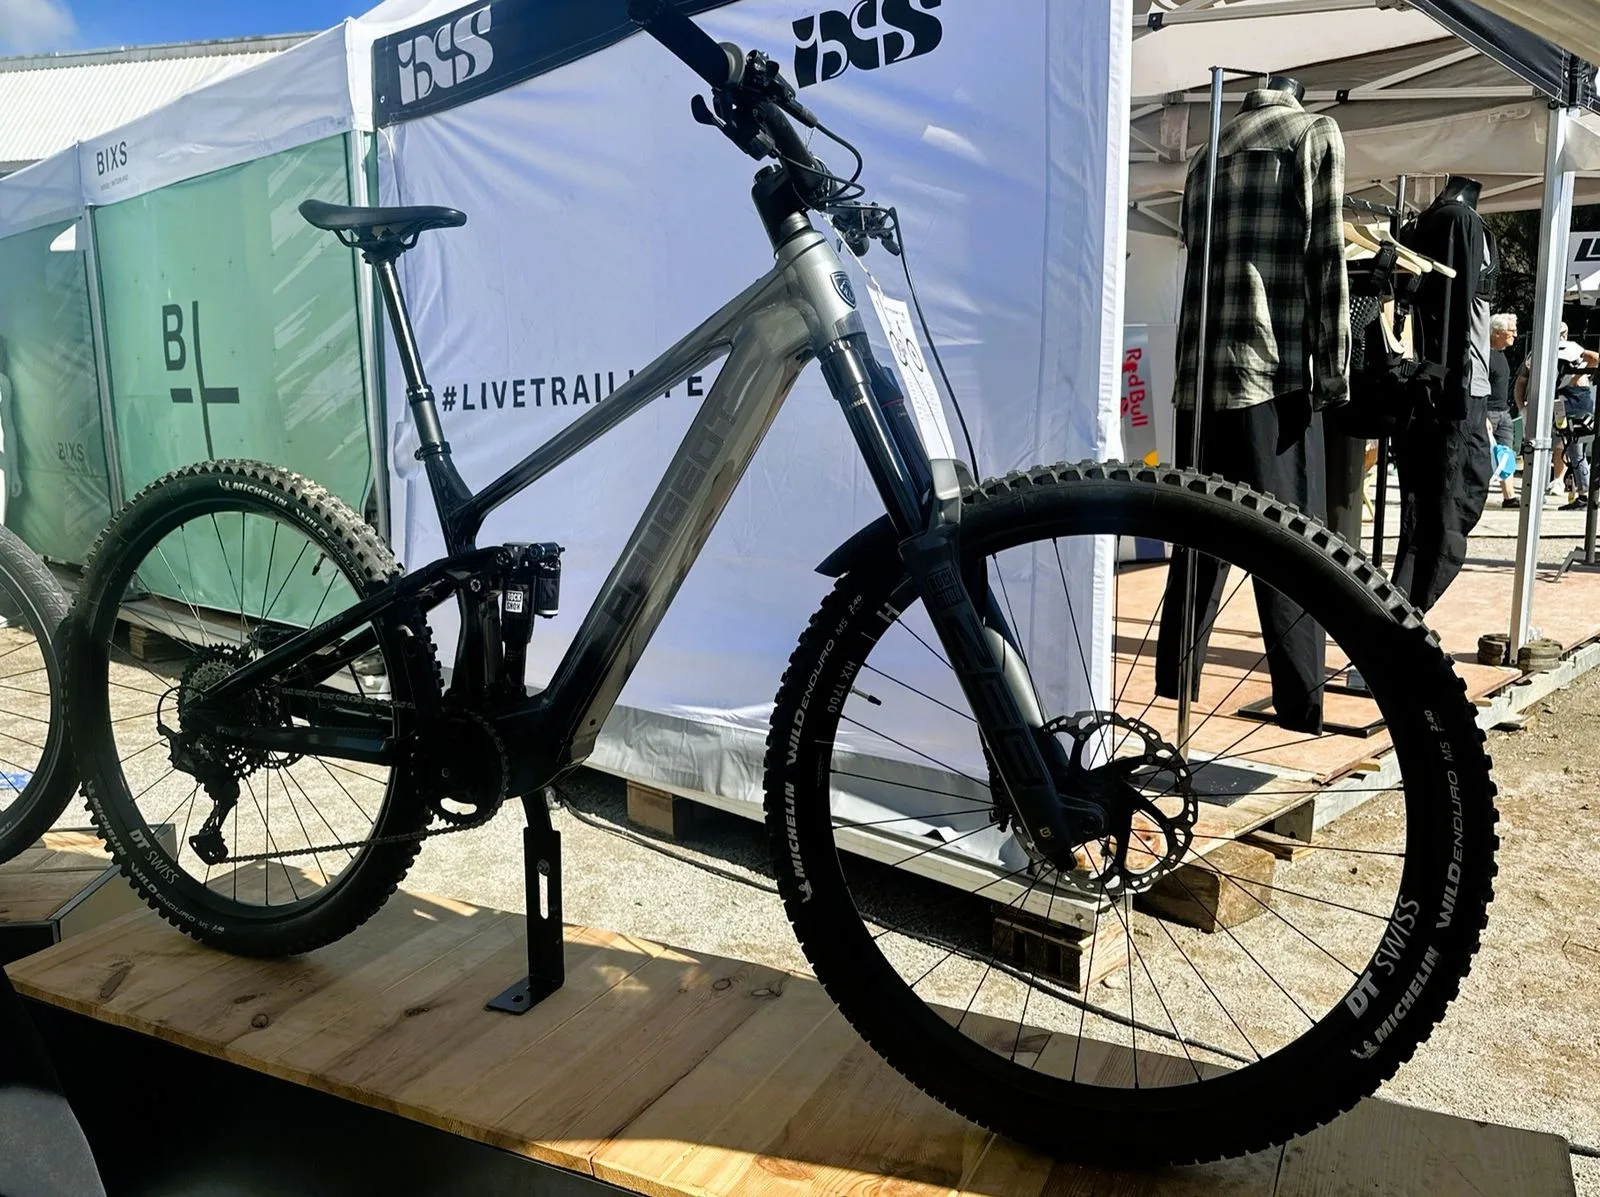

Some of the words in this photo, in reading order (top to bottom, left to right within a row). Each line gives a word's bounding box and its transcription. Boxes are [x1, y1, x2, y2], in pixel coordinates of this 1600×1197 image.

[97, 141, 127, 176] BIXS
[442, 369, 703, 412] #LIVETRAILE
[1129, 390, 1148, 427] Bull
[233, 482, 287, 507] MICHELIN
[840, 661, 856, 680] HX
[827, 684, 846, 713] 1700
[93, 798, 127, 856] MICHELIN
[785, 782, 806, 878] MICHELIN
[129, 829, 150, 849] DT
[145, 850, 180, 885] SWISS
[1374, 945, 1439, 1043] MICHELIN
[1440, 741, 1454, 761] MS
[1345, 970, 1380, 1019] DT
[1375, 895, 1420, 976] SWISS
